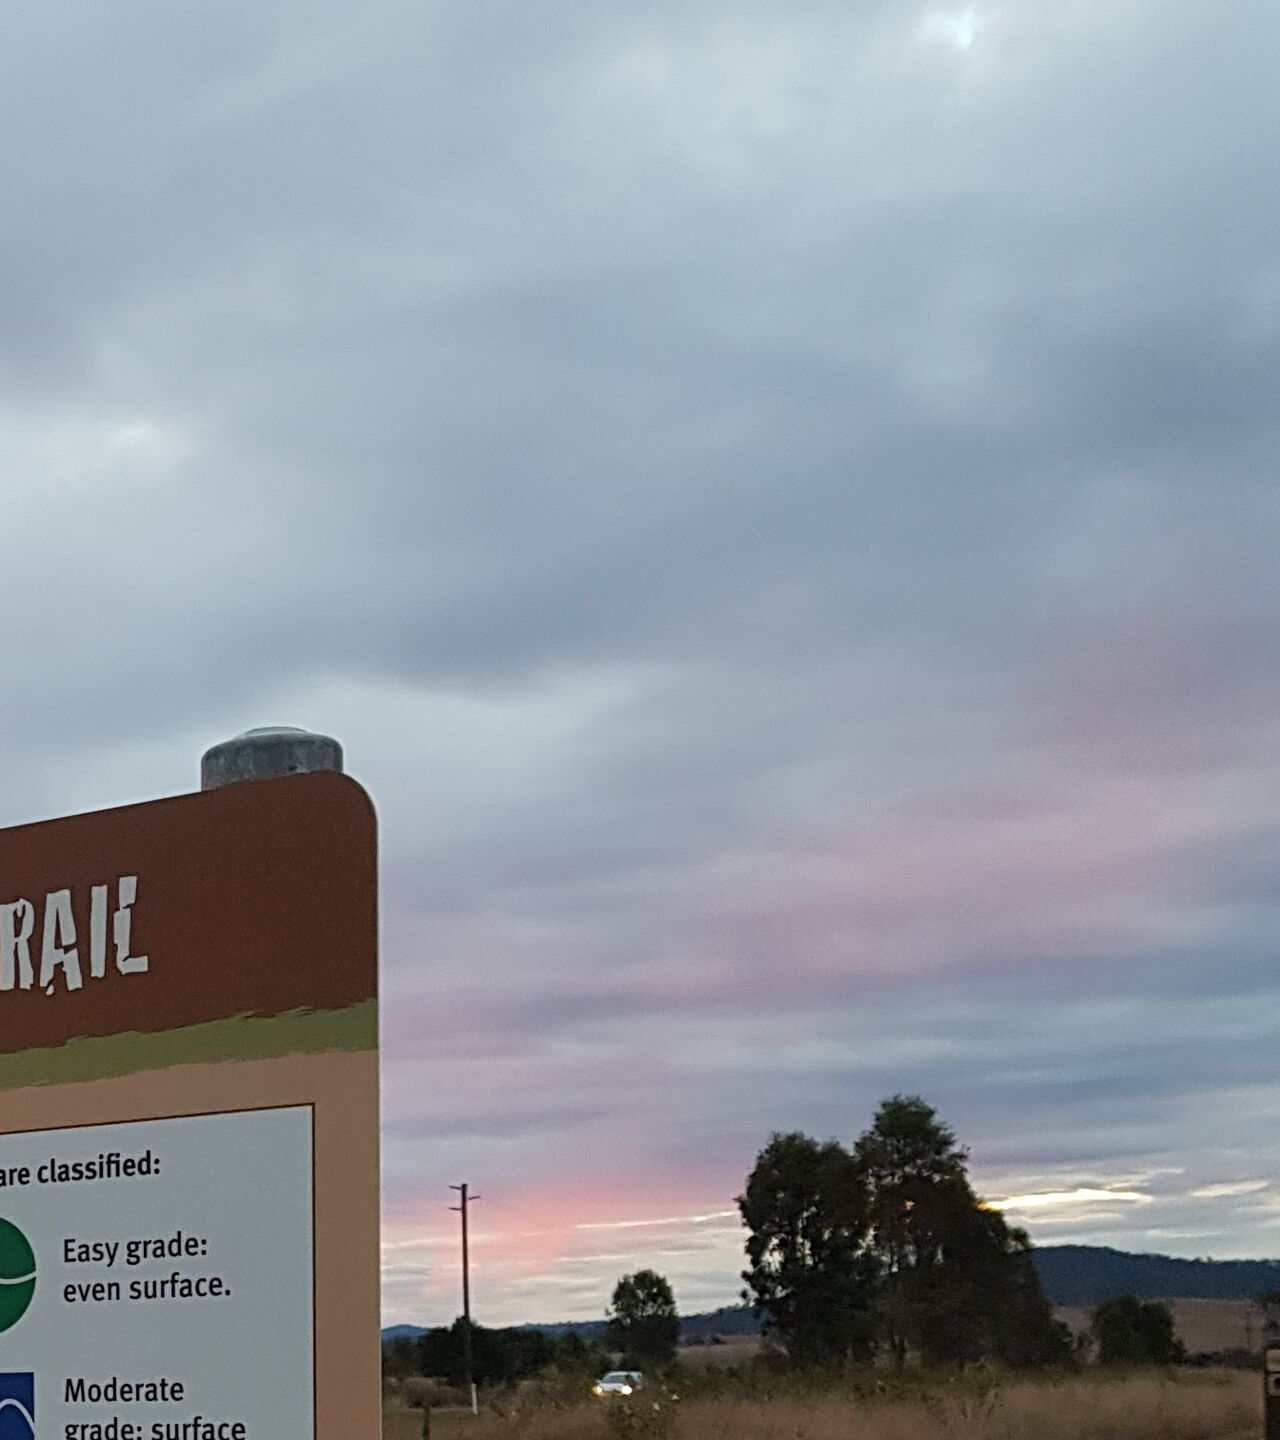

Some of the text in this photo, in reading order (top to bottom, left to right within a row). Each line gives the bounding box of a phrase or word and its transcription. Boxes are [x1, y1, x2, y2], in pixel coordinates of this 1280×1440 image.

[37, 1149, 160, 1184] classified:
[63, 1230, 207, 1268] Easy grade:
[63, 1271, 231, 1303] even surface.
[64, 1376, 184, 1403] Moderate
